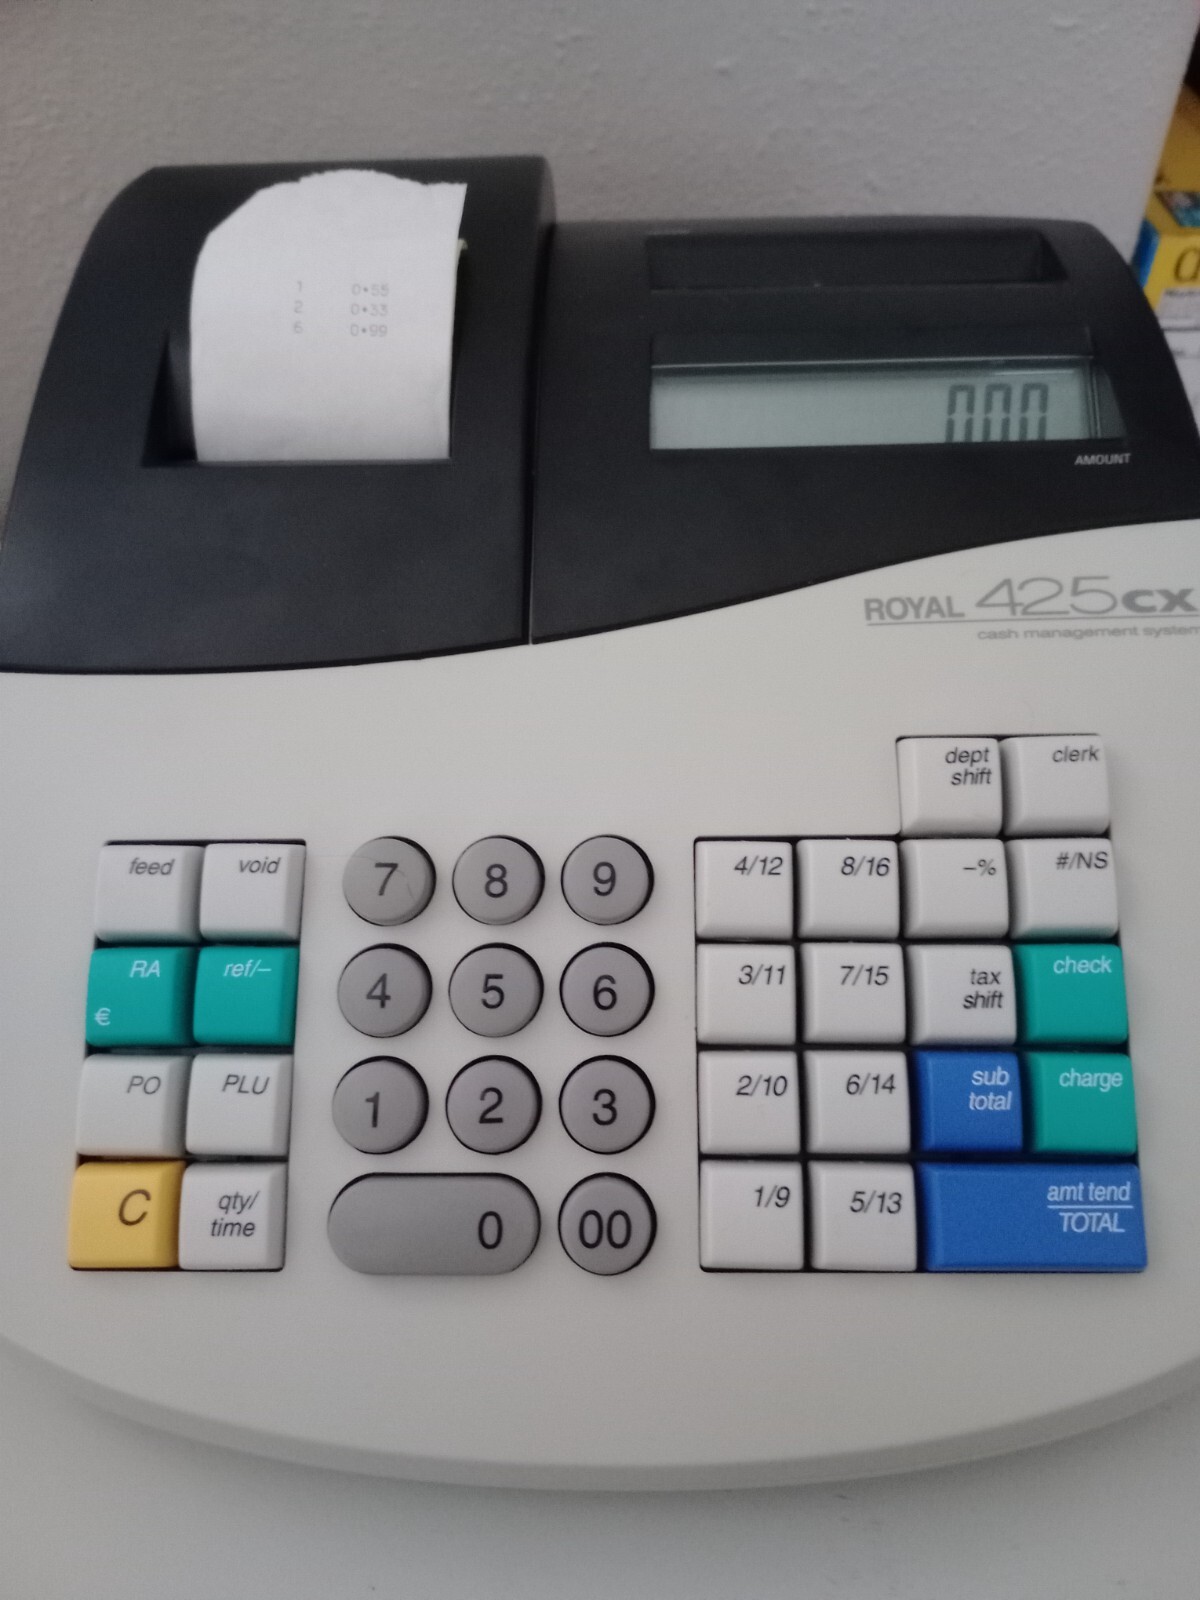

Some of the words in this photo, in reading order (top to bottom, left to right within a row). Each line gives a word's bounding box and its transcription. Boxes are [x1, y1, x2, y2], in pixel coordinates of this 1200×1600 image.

[1075, 453, 1131, 466] AMOUNT
[864, 596, 965, 621] ROYAL
[977, 629, 1018, 640] cash
[1024, 626, 1138, 640] management
[945, 747, 990, 767] dept
[1052, 745, 1099, 763] clerk
[951, 767, 992, 786] shift
[128, 857, 175, 875] feed
[238, 857, 281, 874] void
[734, 855, 784, 876] 4/12
[840, 856, 891, 877] 8/16
[1055, 851, 1108, 870] #/NS
[374, 862, 398, 896] 7
[484, 864, 508, 898] 8
[593, 861, 616, 896] 9
[129, 960, 161, 978] RA
[738, 964, 786, 985] 3/11
[840, 964, 890, 986] 7/15
[1053, 956, 1112, 974] check
[970, 968, 1001, 985] tax
[366, 973, 391, 1009] 4
[481, 973, 505, 1009] 5
[592, 974, 617, 1010] 6
[963, 991, 1003, 1009] shift
[94, 1007, 111, 1026] €
[126, 1075, 162, 1094] PO
[222, 1074, 270, 1094] PLU
[736, 1074, 788, 1096] 2/10
[846, 1073, 896, 1095] 6/14
[971, 1066, 1010, 1086] sub
[1059, 1068, 1123, 1092] charge
[365, 1091, 381, 1128] 1
[478, 1087, 504, 1124] 2
[592, 1088, 618, 1126] 3
[969, 1091, 1012, 1110] total
[754, 1185, 791, 1208] 1/9
[1047, 1182, 1084, 1201] amt
[1089, 1181, 1131, 1201] tend
[118, 1189, 151, 1226] C
[218, 1190, 260, 1214] qty/
[850, 1190, 902, 1214] 5/13
[210, 1219, 255, 1237] time
[478, 1211, 502, 1249] 0
[578, 1209, 632, 1249] 00
[1059, 1212, 1125, 1233] TOTAL
